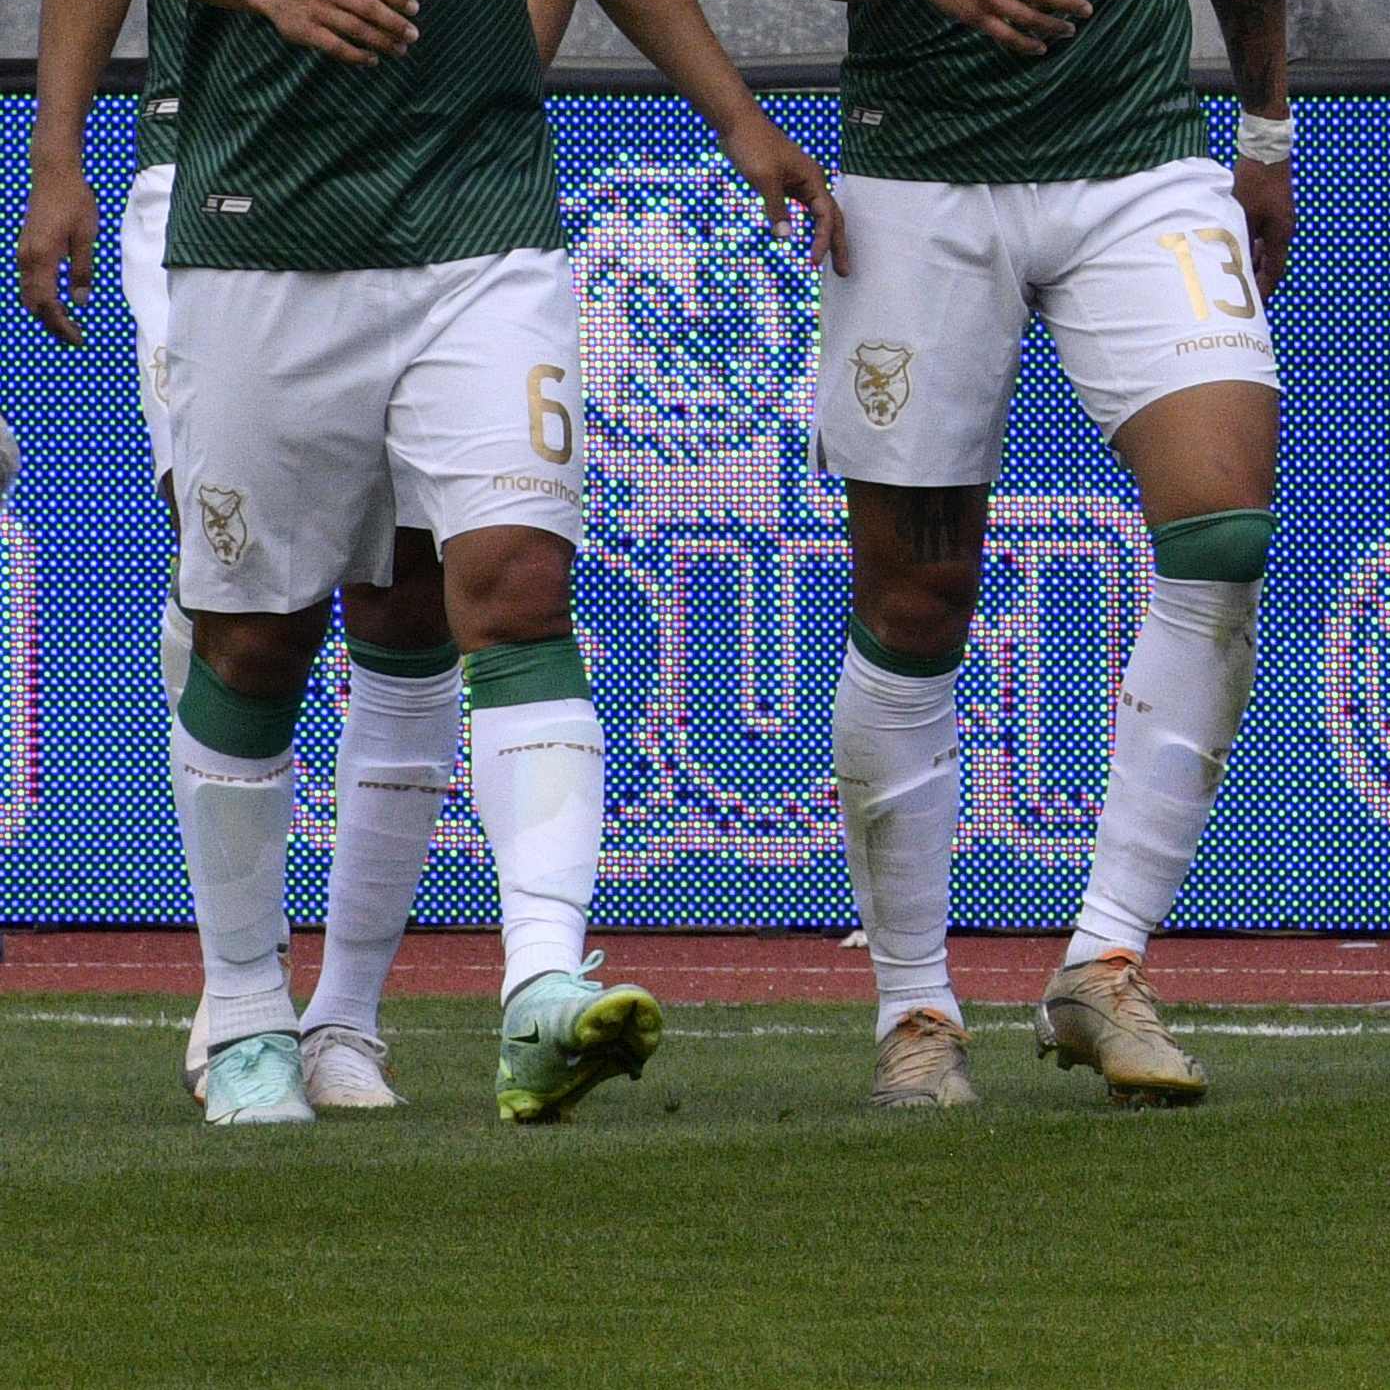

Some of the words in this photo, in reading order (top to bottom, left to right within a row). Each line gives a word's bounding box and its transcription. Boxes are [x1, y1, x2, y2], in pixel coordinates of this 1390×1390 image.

[1156, 227, 1256, 321] 13
[527, 364, 573, 465] 6
[493, 474, 586, 508] maratho
